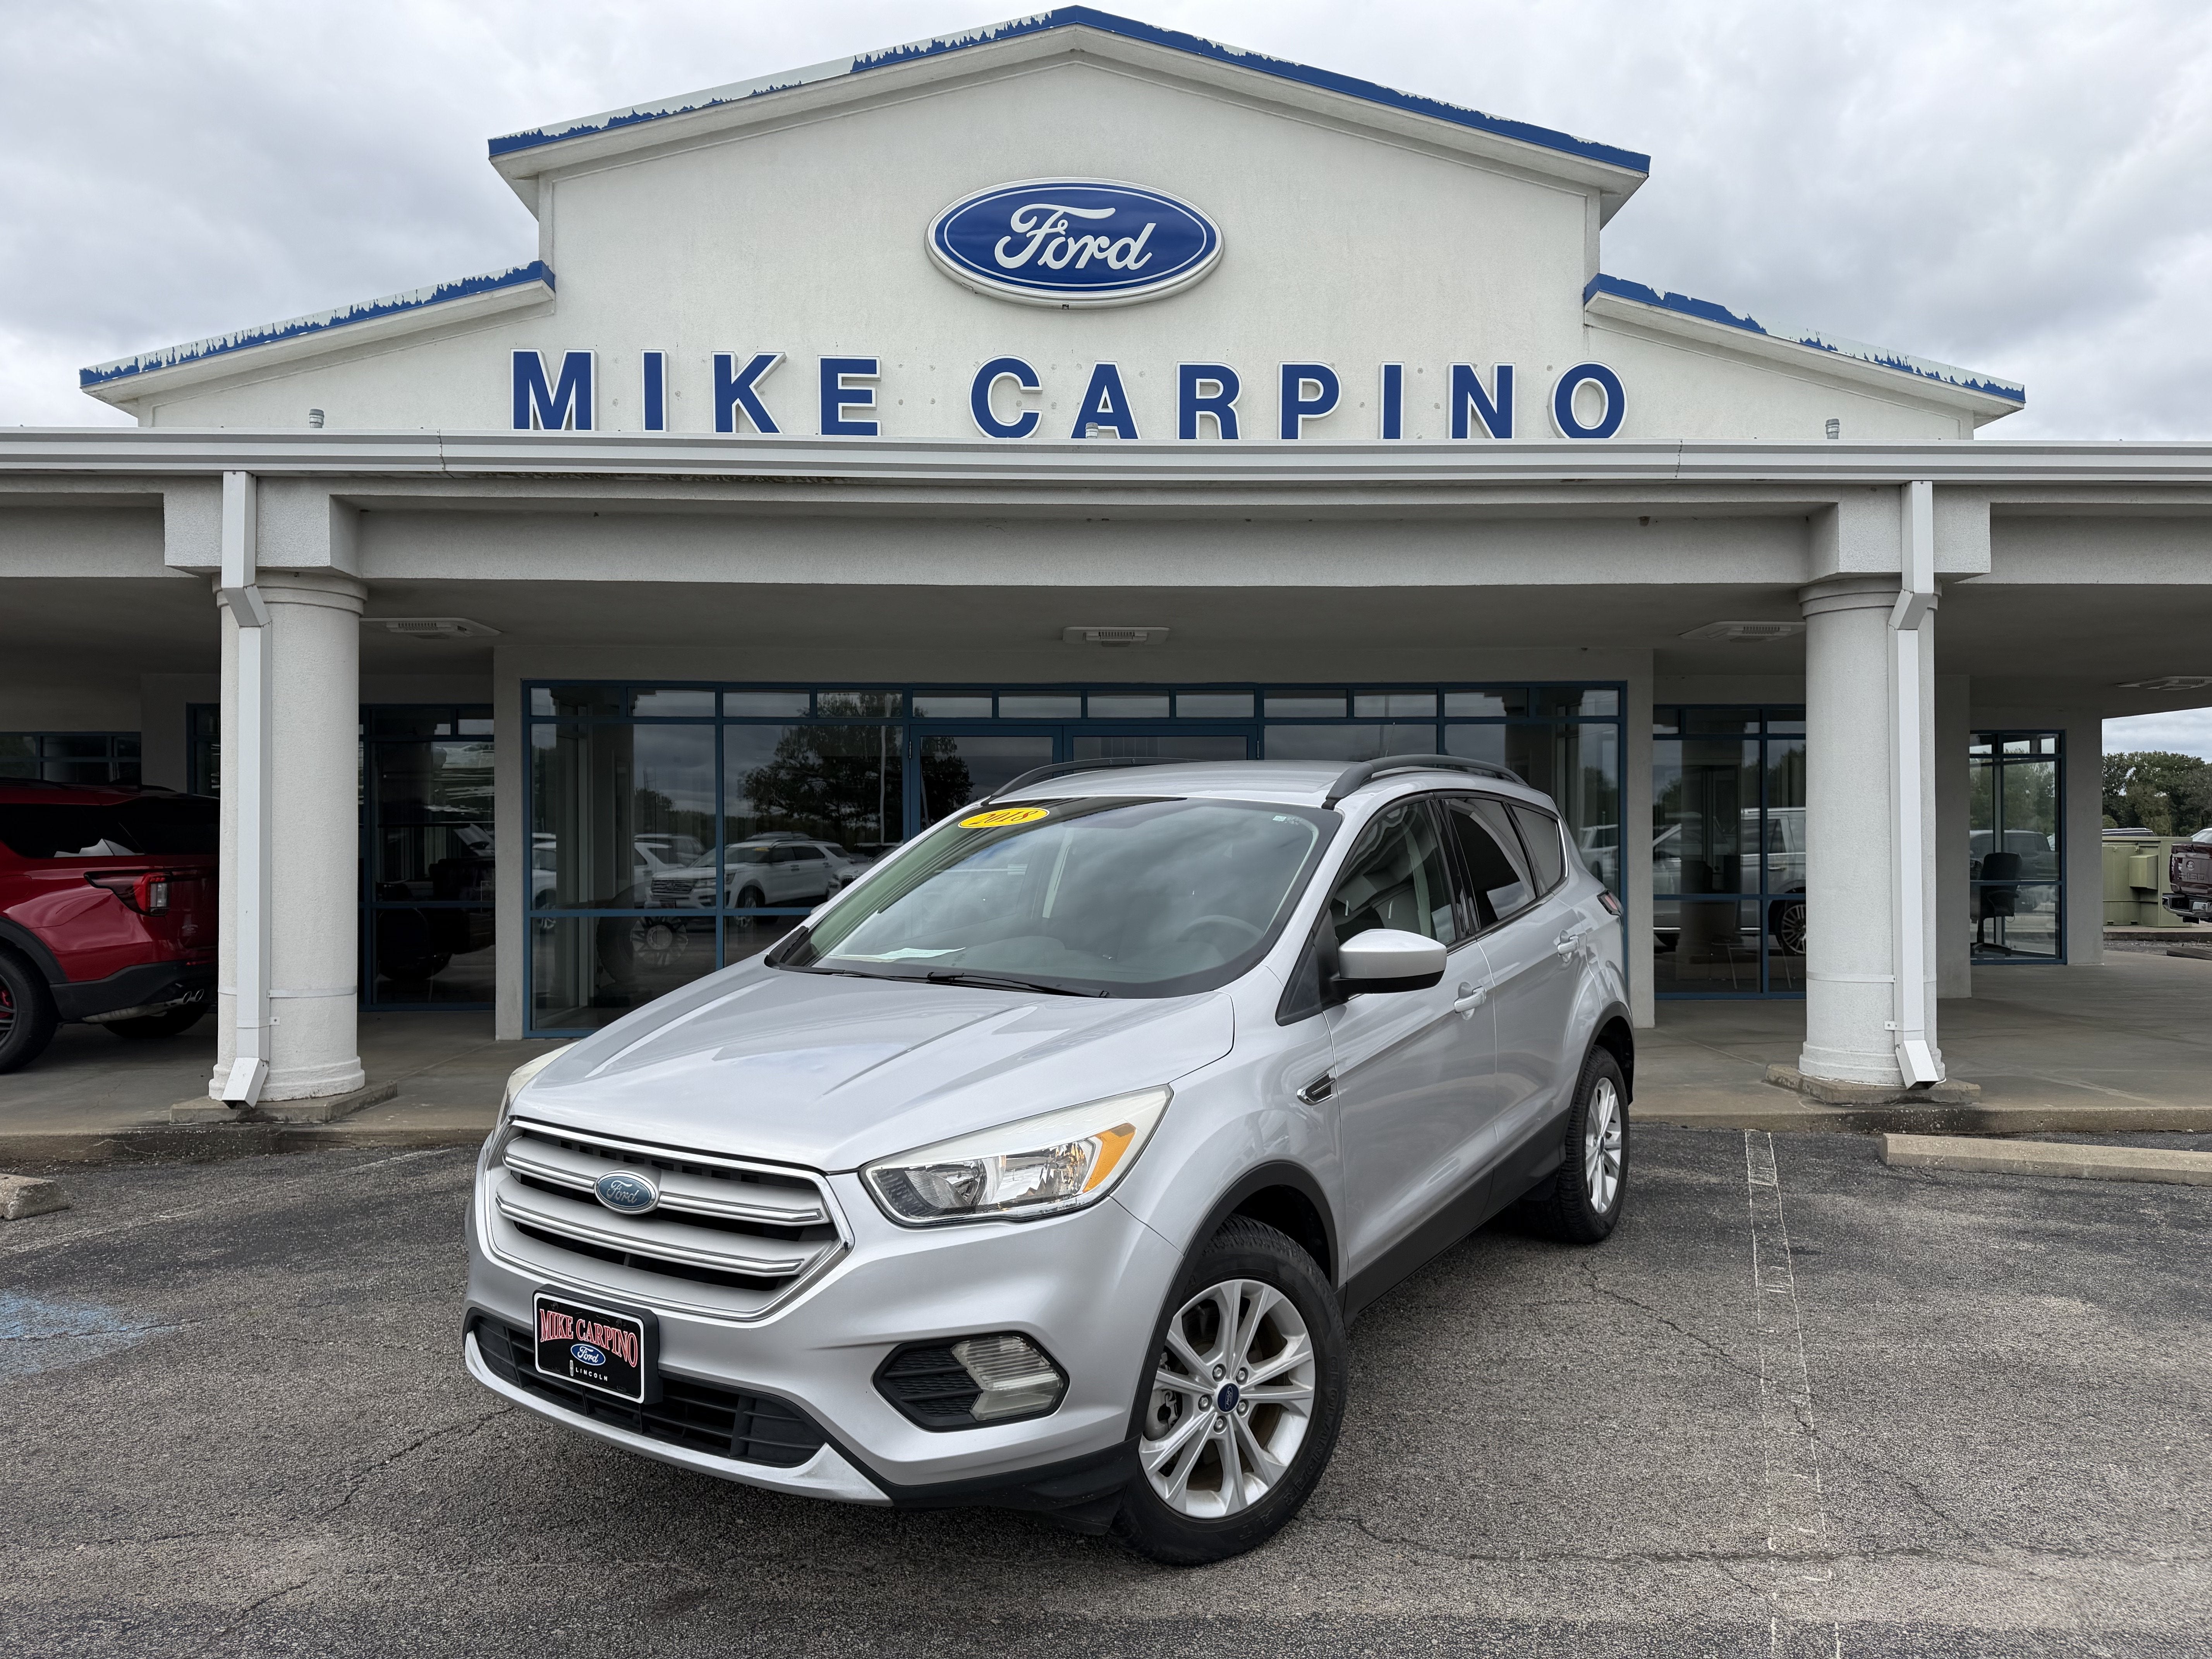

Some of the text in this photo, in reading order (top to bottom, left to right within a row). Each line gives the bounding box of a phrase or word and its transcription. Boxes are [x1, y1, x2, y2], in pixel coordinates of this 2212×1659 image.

[994, 203, 1156, 270] Ford
[510, 349, 1628, 439] MIKE CARPINO
[968, 811, 1039, 826] 2018
[606, 1180, 639, 1204] Ford
[539, 1309, 638, 1368] MIKE CARPINO
[577, 1346, 599, 1364] Ford
[575, 1367, 608, 1382] LINCOLN
